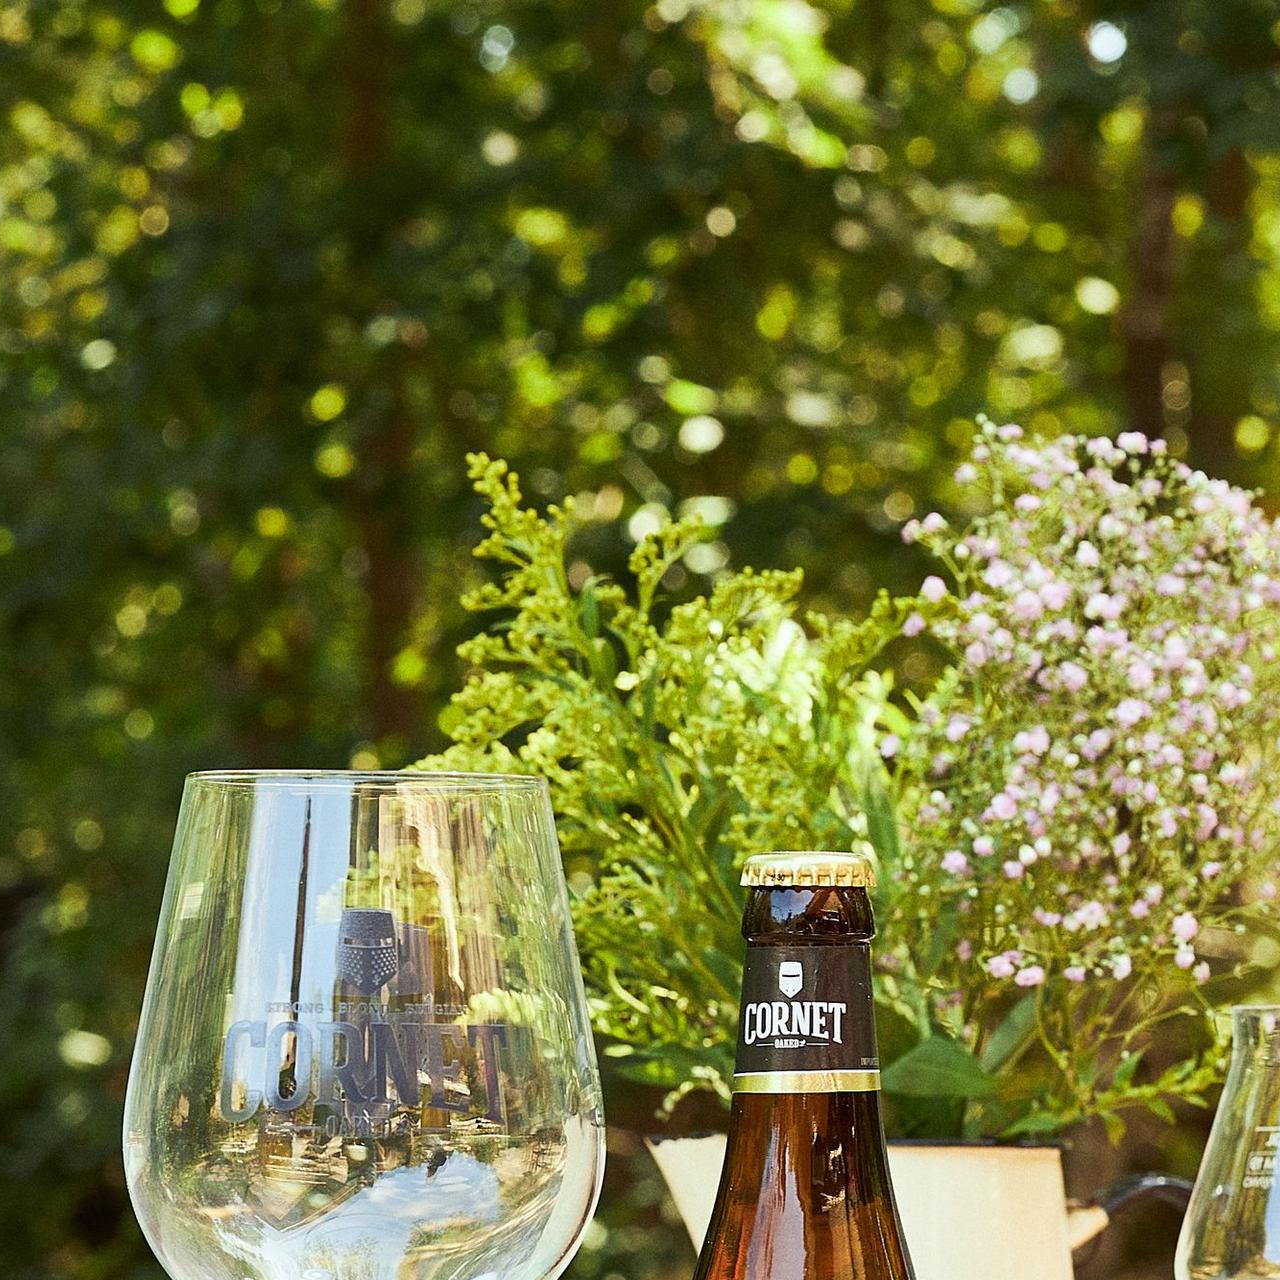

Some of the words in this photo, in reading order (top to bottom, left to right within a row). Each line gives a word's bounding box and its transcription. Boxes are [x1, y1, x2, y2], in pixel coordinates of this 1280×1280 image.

[744, 1001, 847, 1045] CORNET
[774, 1039, 799, 1049] OAKED
[220, 1020, 507, 1125] CORNET
